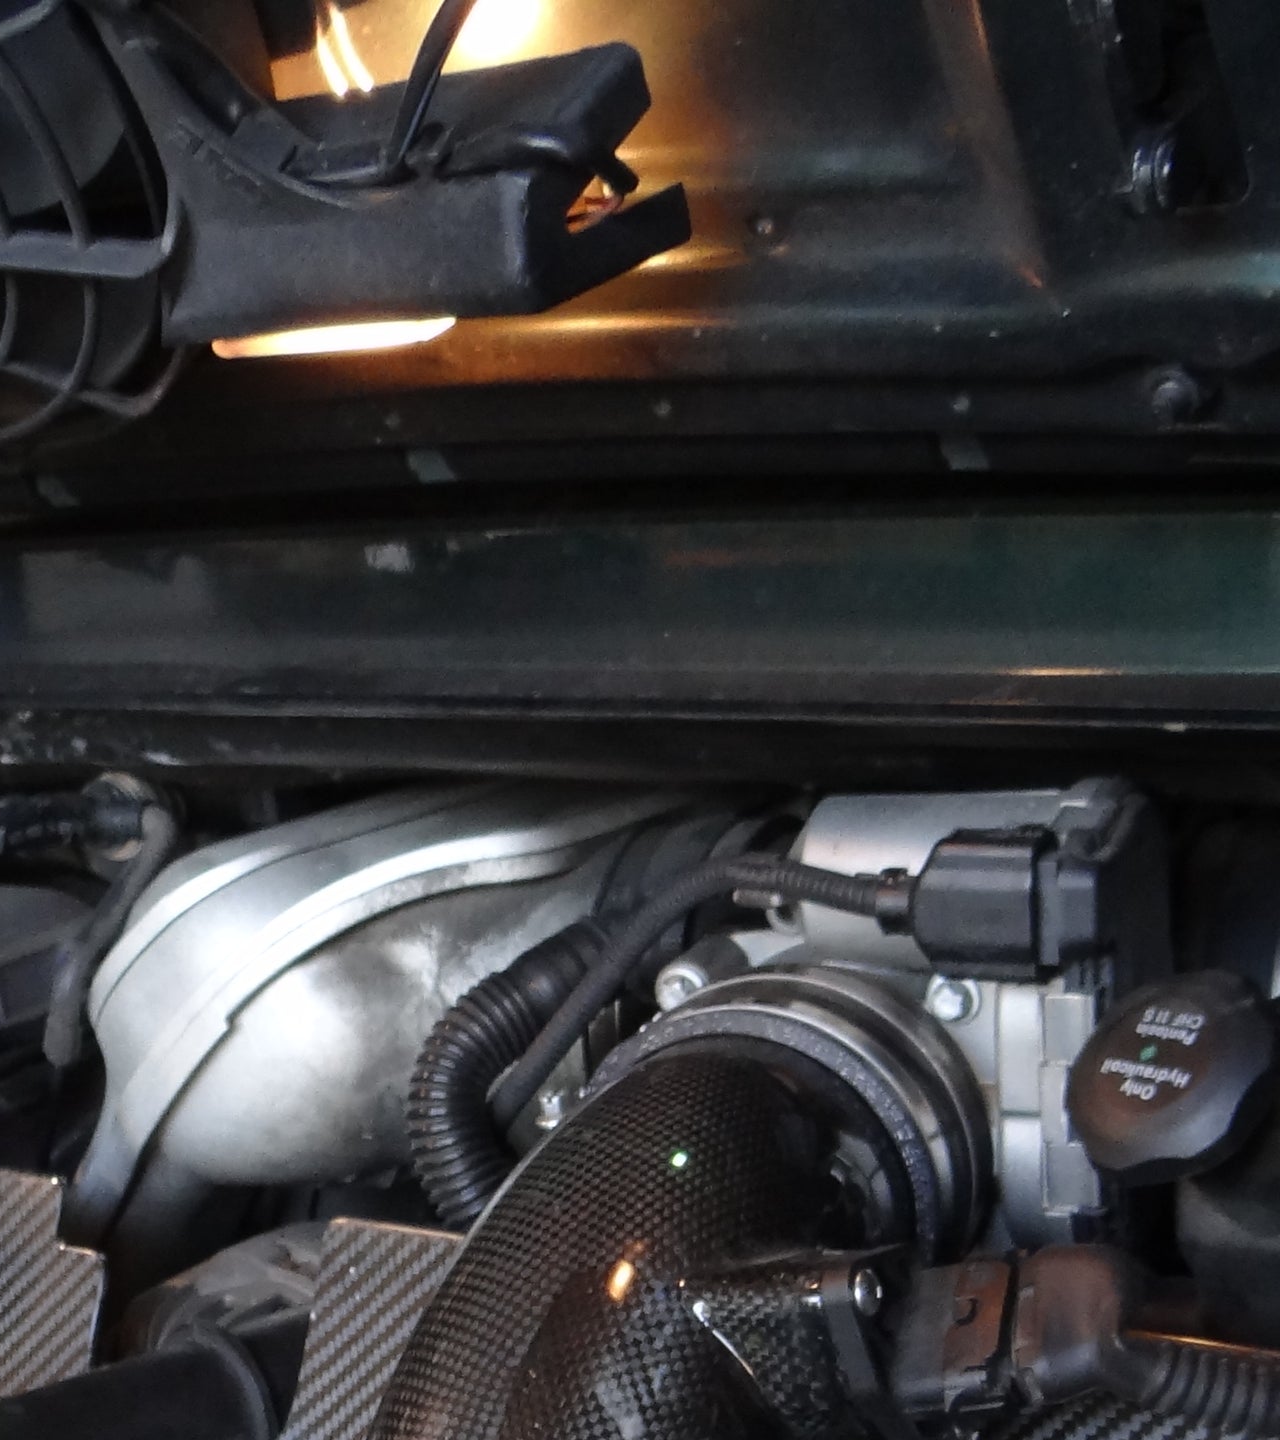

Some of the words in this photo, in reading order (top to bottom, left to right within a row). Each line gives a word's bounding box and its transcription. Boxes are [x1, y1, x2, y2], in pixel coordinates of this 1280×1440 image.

[1171, 1012, 1206, 1030] CHF
[1136, 1023, 1200, 1046] Pentosin
[1100, 1057, 1192, 1089] Hydraulicoil
[1120, 1078, 1158, 1100] Only
